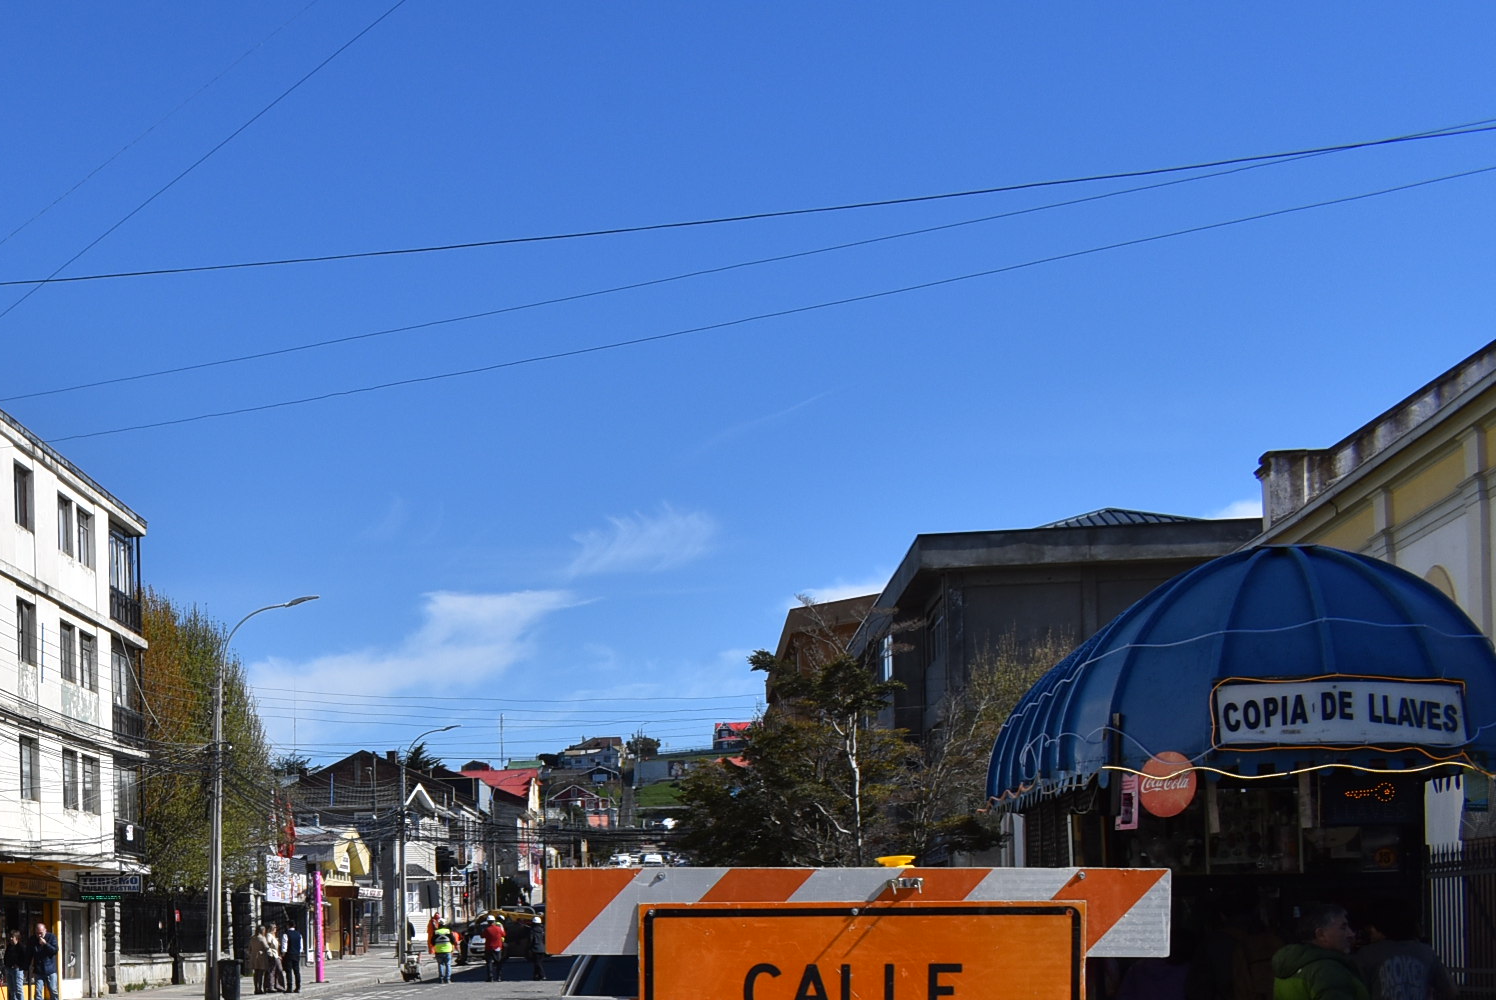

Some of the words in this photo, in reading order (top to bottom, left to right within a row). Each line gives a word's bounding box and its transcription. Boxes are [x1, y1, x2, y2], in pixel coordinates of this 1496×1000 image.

[1222, 693, 1308, 732] COPIA
[1319, 690, 1355, 721] DE
[1367, 692, 1459, 733] LLAVES
[81, 876, 138, 885] TURISMO
